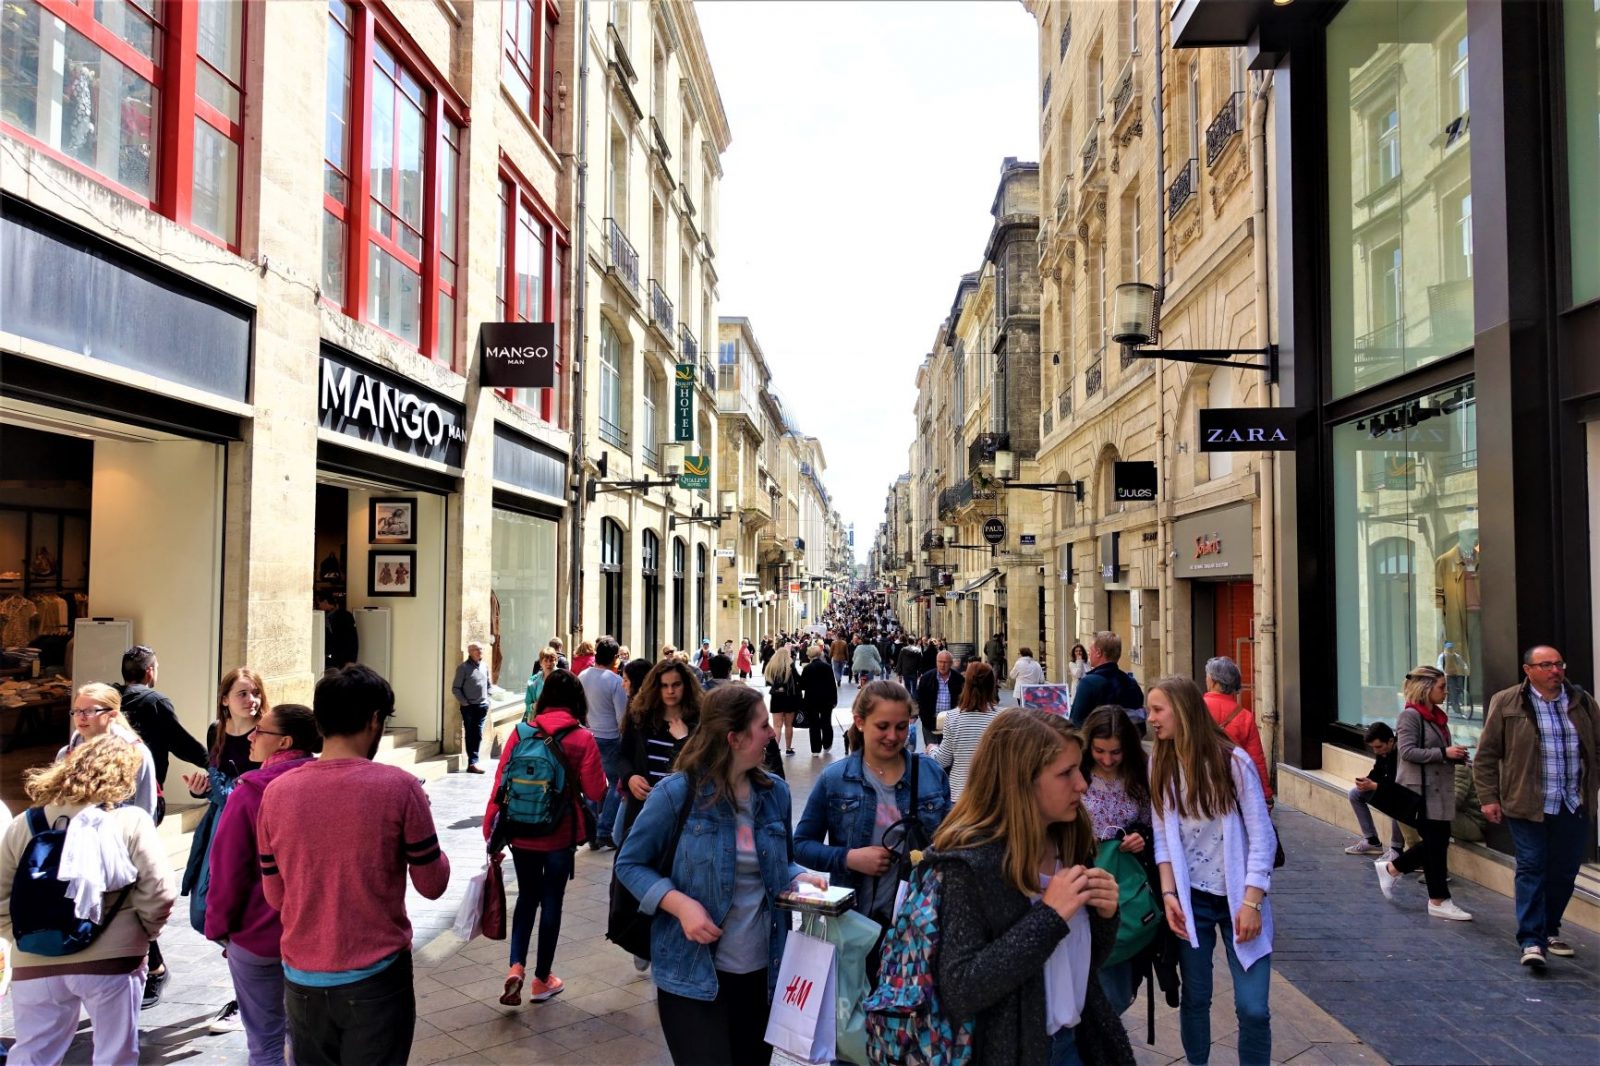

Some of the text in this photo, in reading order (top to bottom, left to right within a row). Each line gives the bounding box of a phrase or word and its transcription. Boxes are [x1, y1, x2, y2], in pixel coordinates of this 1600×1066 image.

[486, 346, 548, 358] MANGO
[321, 357, 467, 446] MANGO MAN
[680, 388, 689, 438] HOTEL
[1207, 427, 1288, 442] ZARA
